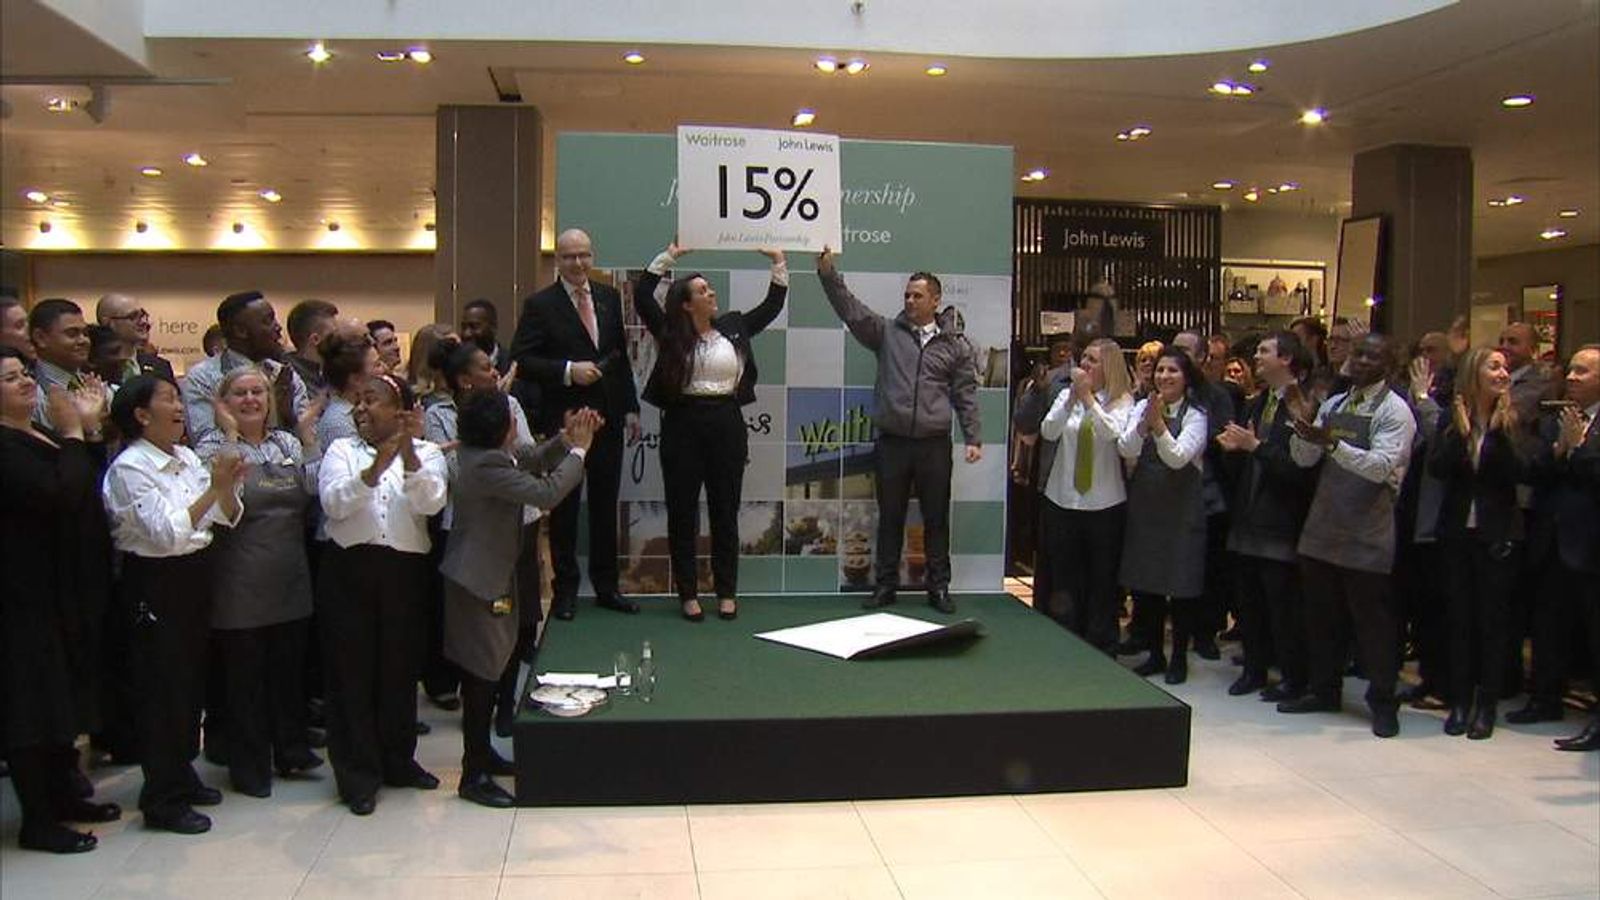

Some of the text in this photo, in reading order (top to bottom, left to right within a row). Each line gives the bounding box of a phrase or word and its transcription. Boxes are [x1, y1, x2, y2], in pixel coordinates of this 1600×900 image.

[685, 133, 746, 149] Waitrose
[778, 136, 833, 152] John Lewis
[718, 164, 819, 221] 15%
[841, 180, 917, 214] nership
[844, 225, 891, 243] trose
[1063, 228, 1146, 250] John Lewis
[159, 318, 198, 334] here
